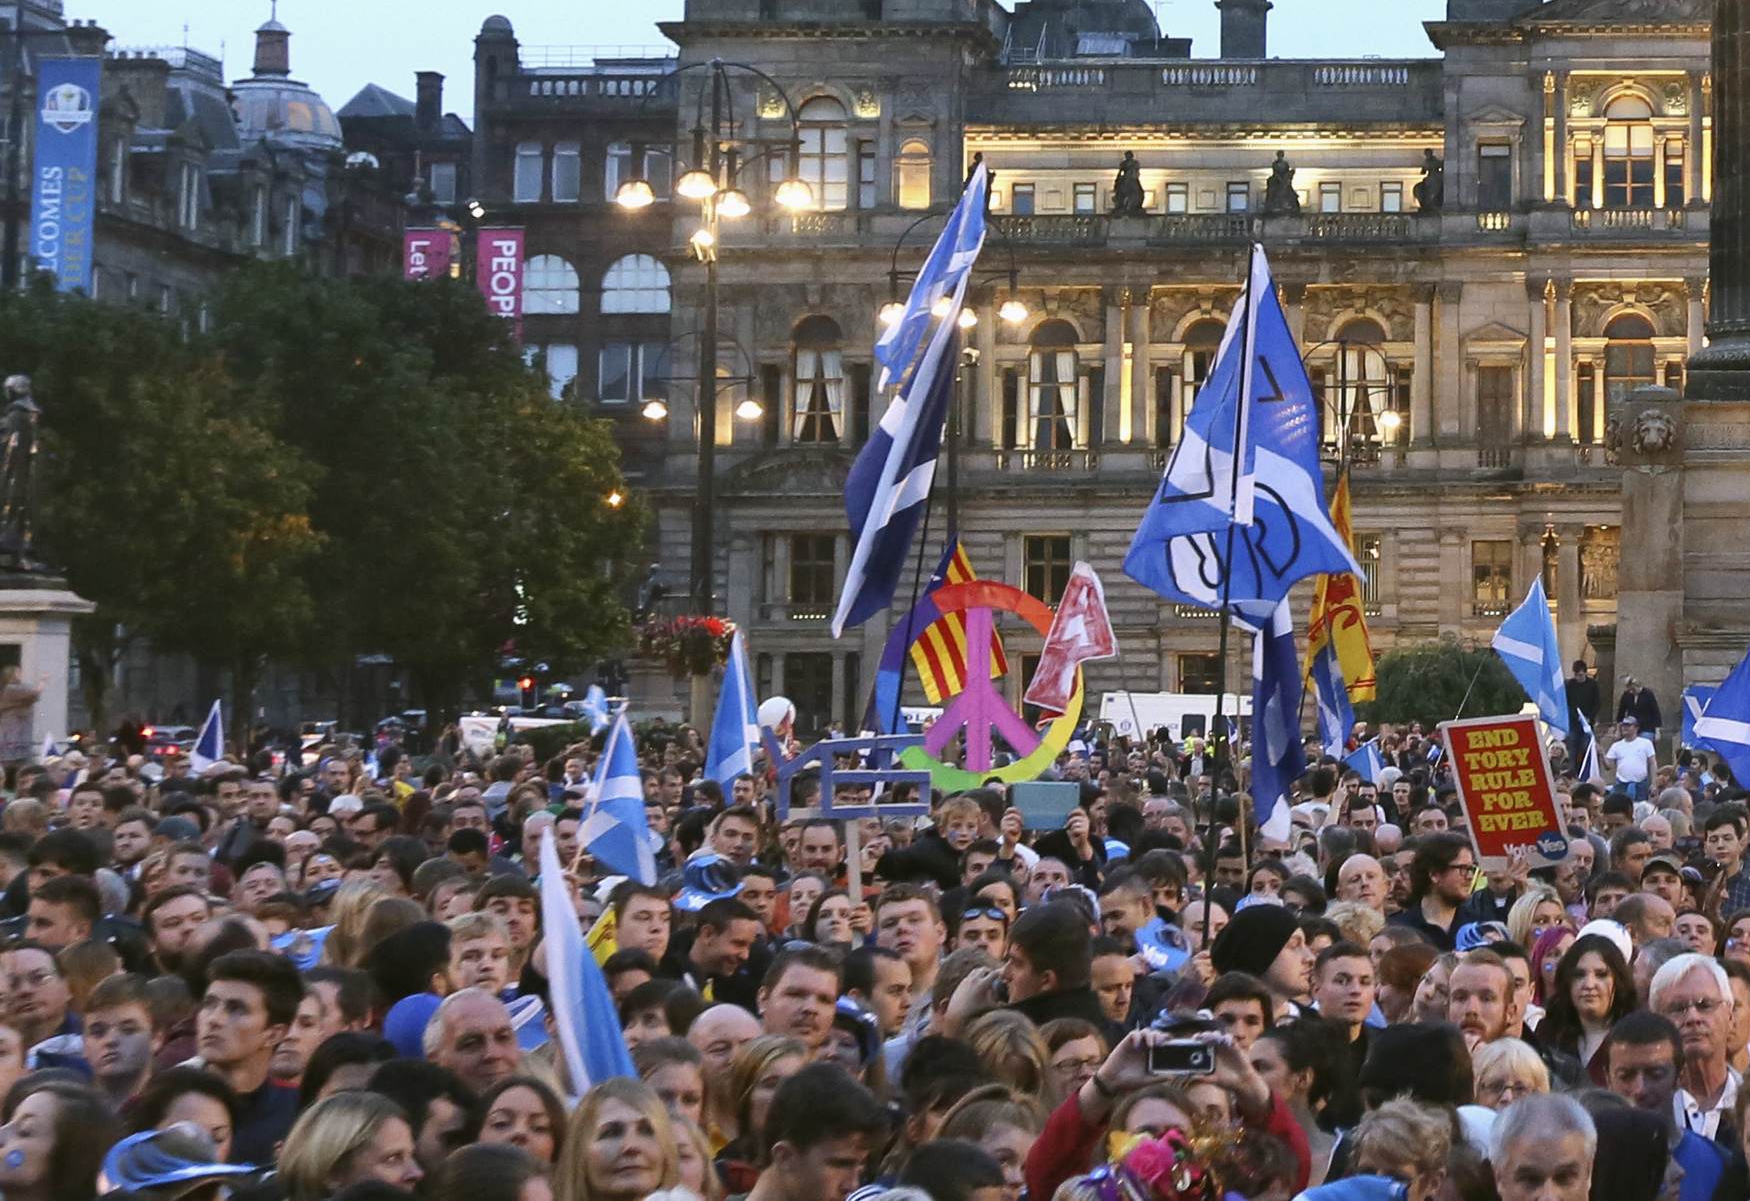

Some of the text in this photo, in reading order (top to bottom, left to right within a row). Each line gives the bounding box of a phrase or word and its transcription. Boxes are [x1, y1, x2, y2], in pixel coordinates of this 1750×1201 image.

[1466, 728, 1519, 749] END
[1464, 748, 1530, 770] TORY
[1469, 769, 1537, 791] RULE
[1481, 790, 1534, 811] FOR
[1478, 810, 1549, 832] EVER
[1503, 838, 1566, 858] Vote Yes
